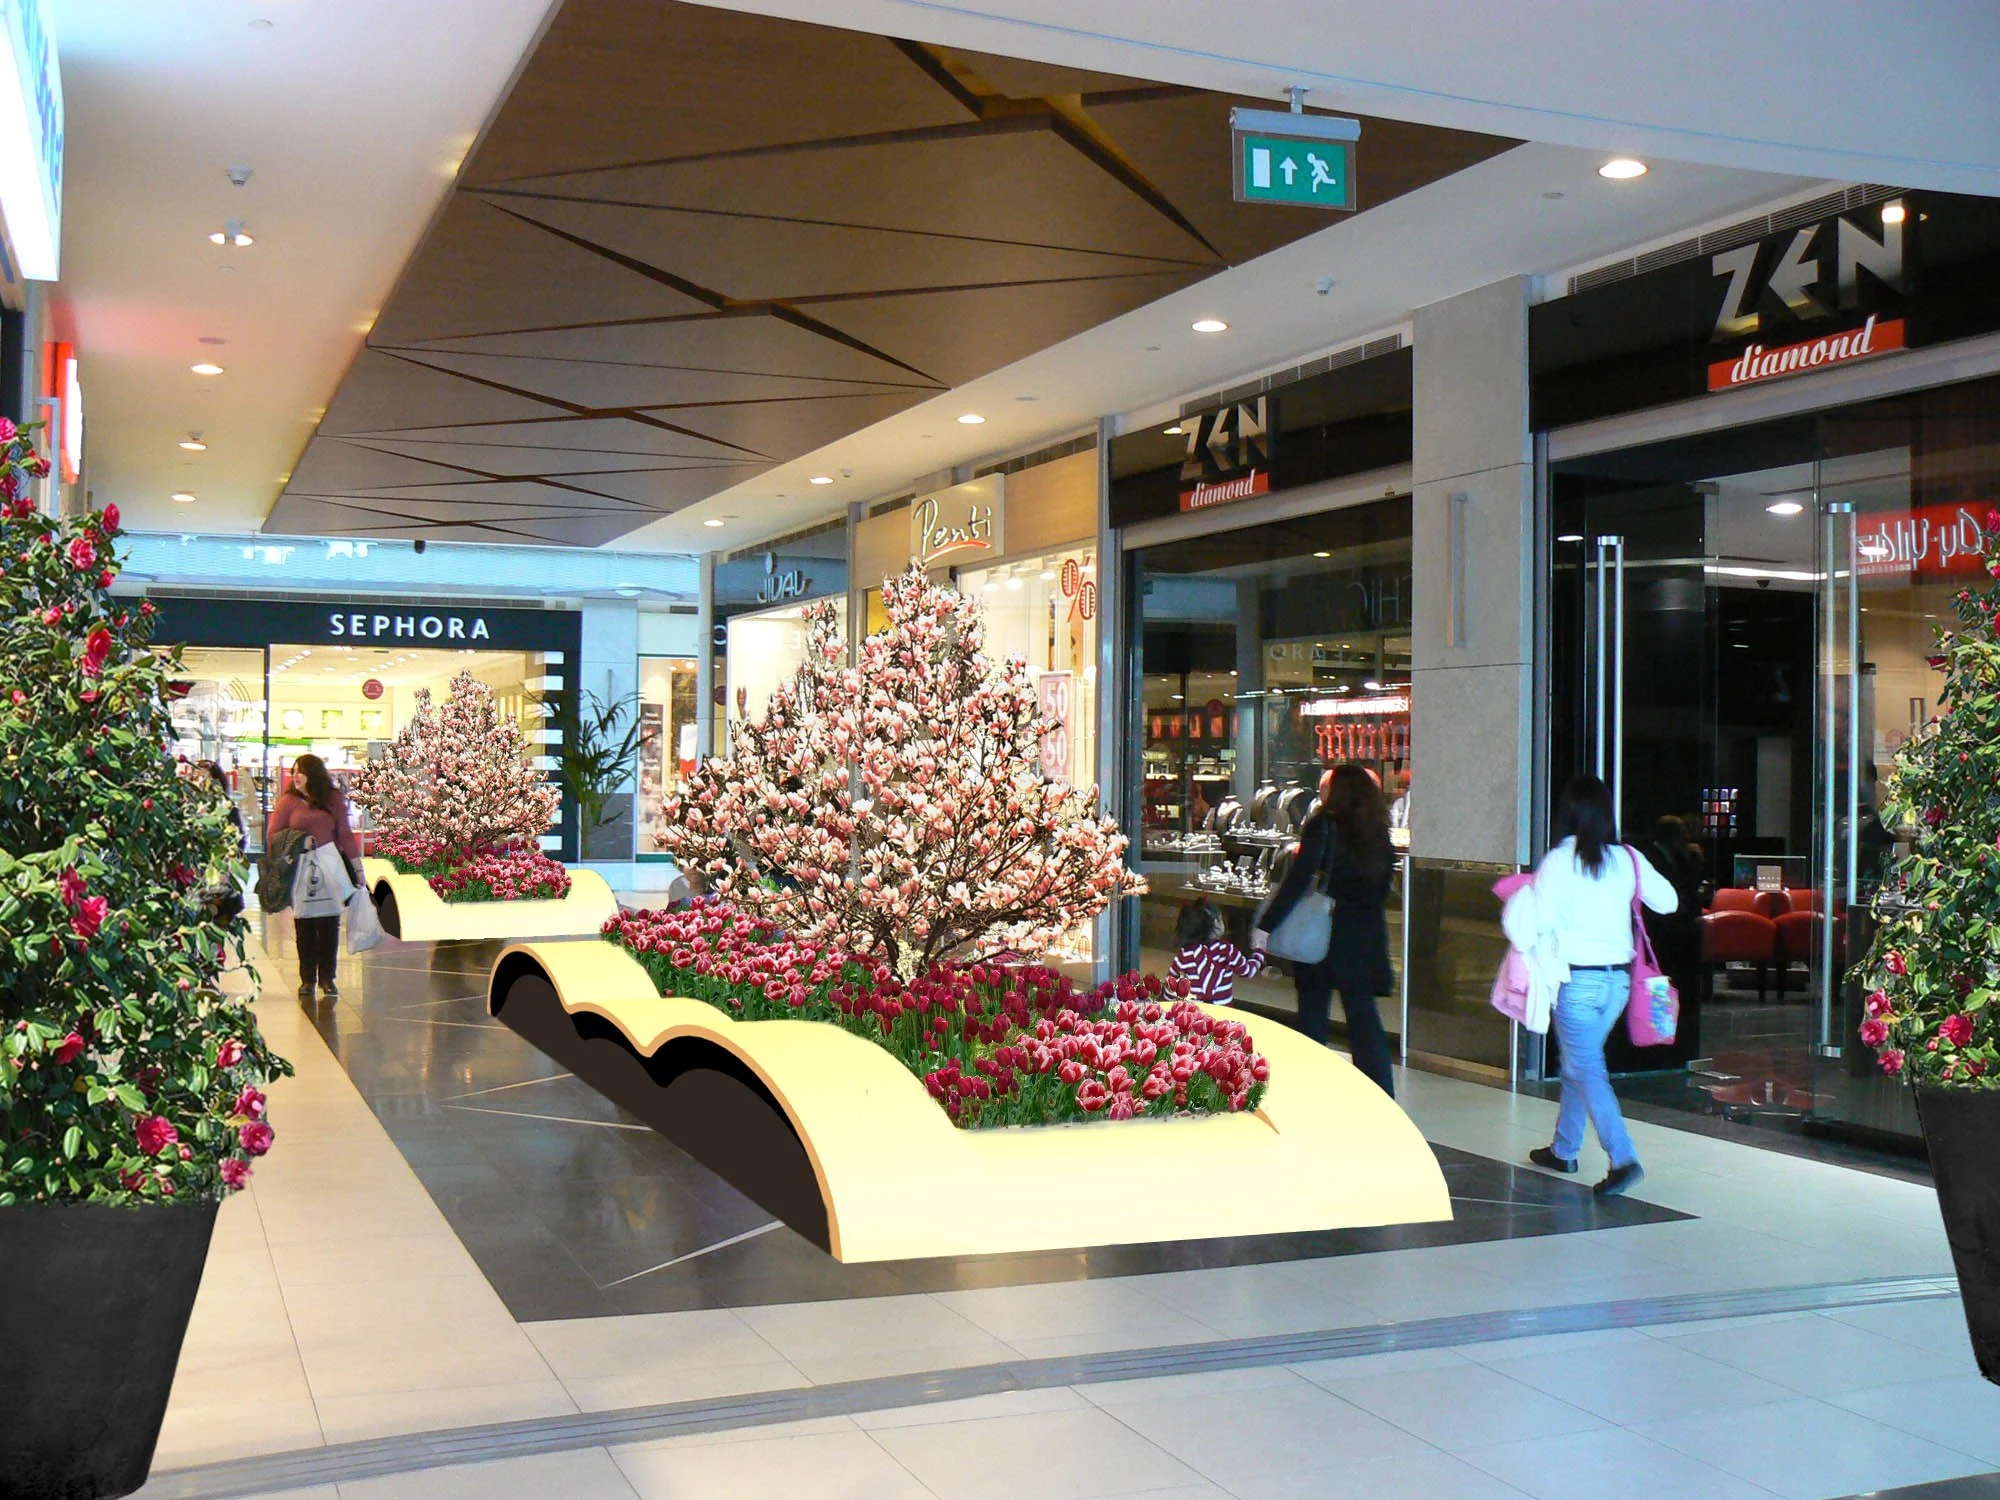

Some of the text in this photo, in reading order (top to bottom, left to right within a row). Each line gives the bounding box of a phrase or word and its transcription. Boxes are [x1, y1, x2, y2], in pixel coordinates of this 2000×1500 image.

[1709, 198, 1905, 343] ZEN
[1731, 313, 1878, 383] diamond
[1180, 395, 1269, 481] ZEN
[1190, 467, 1256, 508] diamond
[913, 498, 992, 557] Penti
[330, 613, 490, 640] SEPHORA
[1046, 681, 1068, 719] 50
